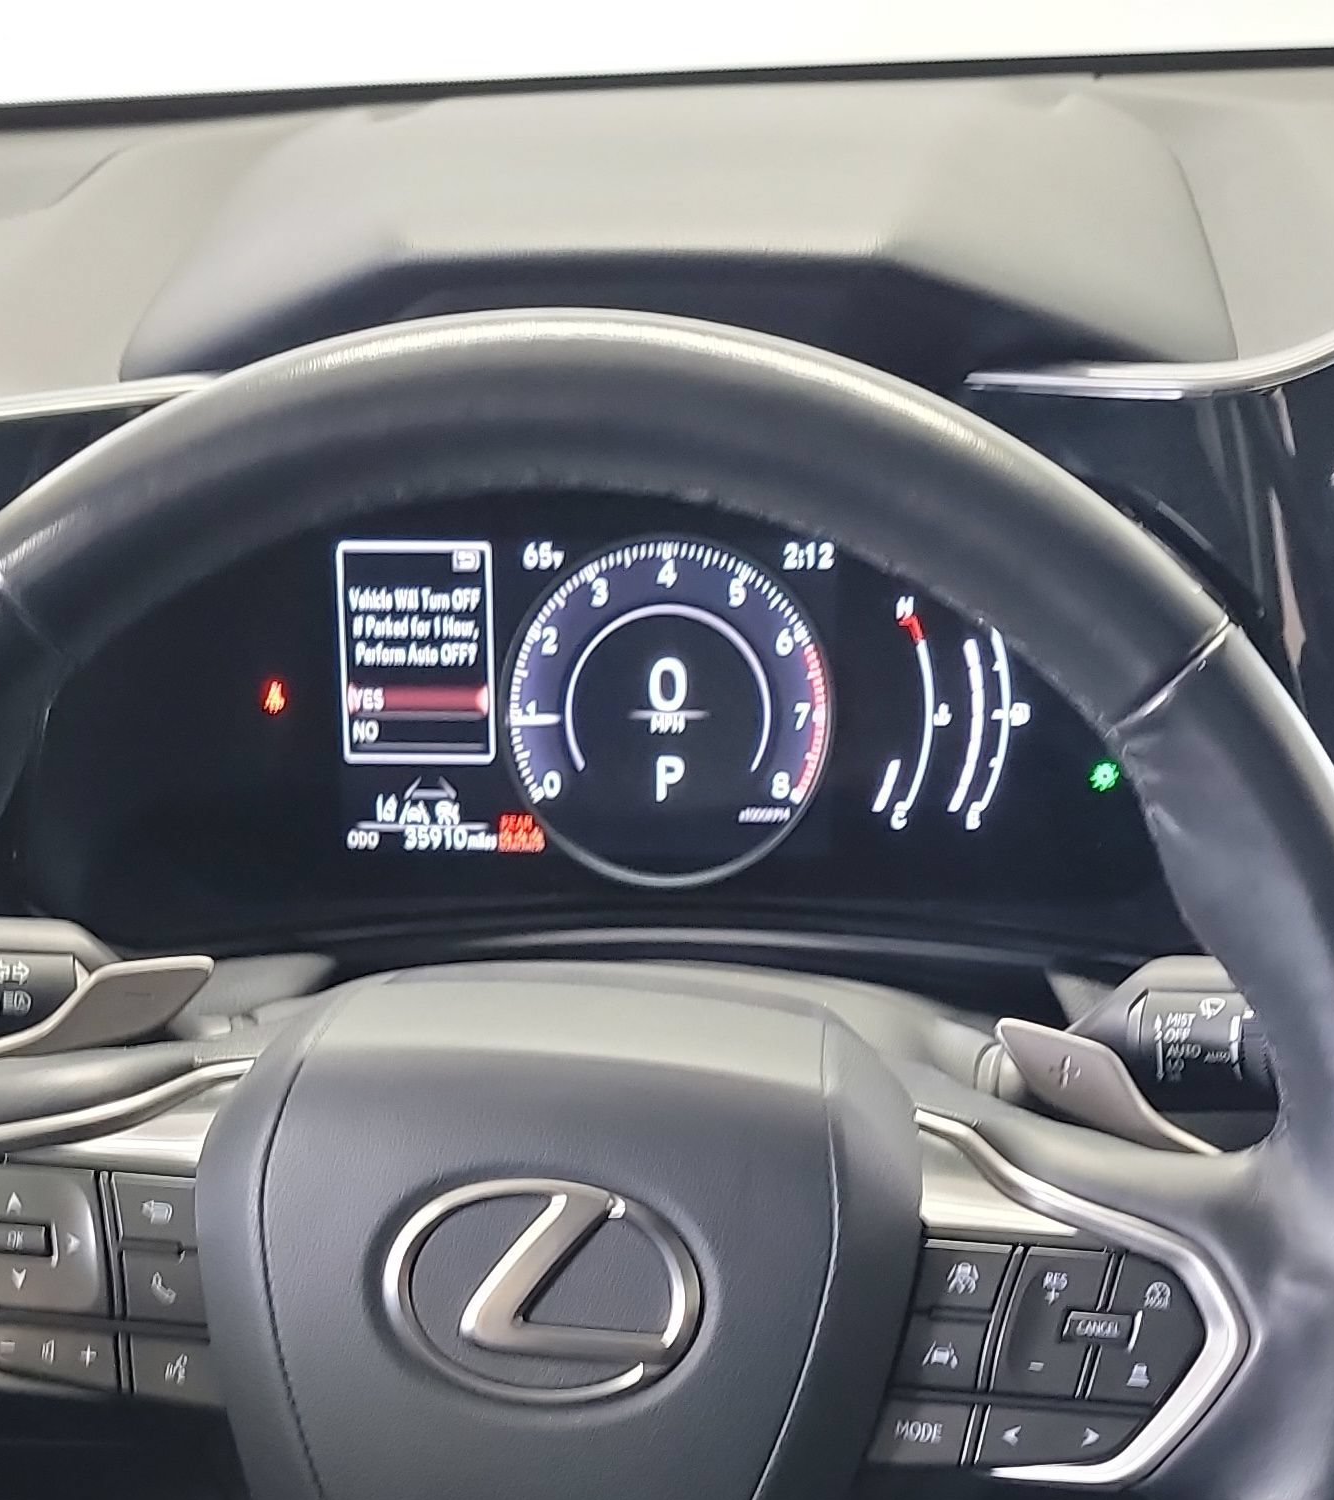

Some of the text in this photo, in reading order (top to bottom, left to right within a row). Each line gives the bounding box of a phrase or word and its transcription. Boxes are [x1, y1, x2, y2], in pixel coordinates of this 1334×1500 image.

[782, 541, 835, 570] 2:12
[656, 558, 678, 588] 4
[349, 587, 481, 612] Vehicle Will Turn OFF
[590, 577, 609, 608] 3
[729, 578, 747, 608] 5
[896, 596, 914, 620] H
[352, 614, 480, 641] If Parked for 1 Hour,
[541, 625, 559, 656] 2
[355, 641, 478, 667] Perform Auto OFF?
[775, 627, 794, 657] 6
[648, 656, 688, 712] 0
[352, 687, 385, 712] YES
[650, 713, 686, 734] MPH
[793, 702, 810, 730] 7
[352, 719, 380, 743] NO
[542, 769, 562, 799] 0
[655, 755, 686, 803] P
[771, 771, 791, 800] 8
[347, 826, 498, 851] ODO 35910 miles
[1166, 1012, 1197, 1029] MIST
[1164, 1027, 1191, 1044] OFF
[1166, 1043, 1202, 1060] AUTO
[1042, 1271, 1068, 1291] RES
[1076, 1319, 1121, 1338] CANCEL
[895, 1419, 944, 1444] MODE
